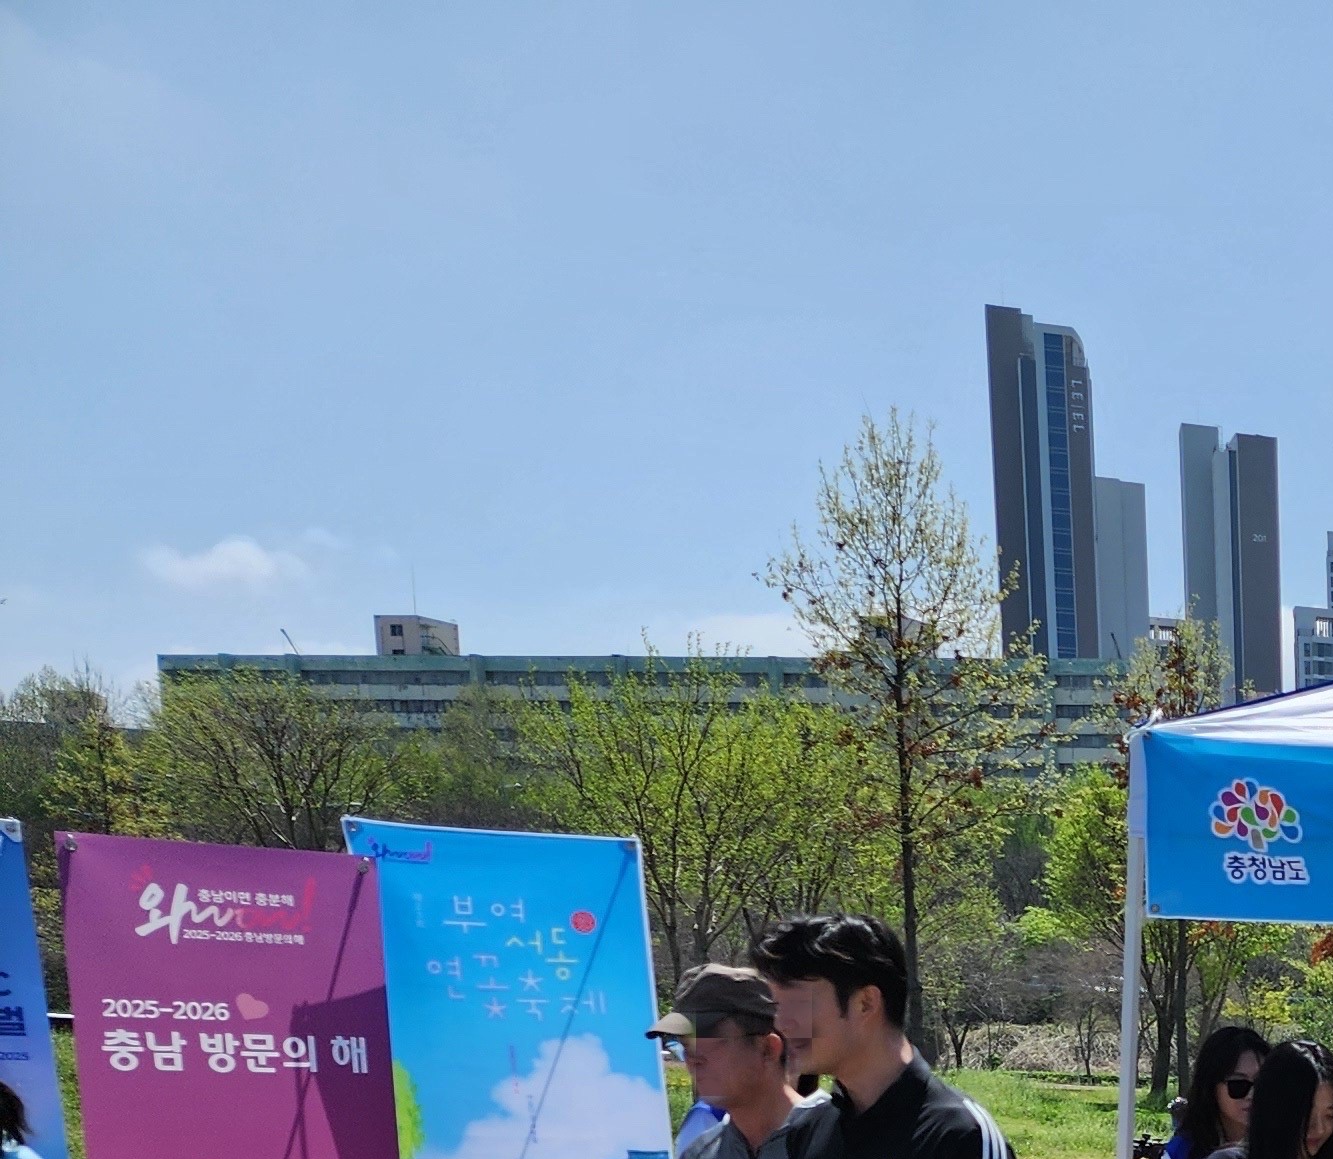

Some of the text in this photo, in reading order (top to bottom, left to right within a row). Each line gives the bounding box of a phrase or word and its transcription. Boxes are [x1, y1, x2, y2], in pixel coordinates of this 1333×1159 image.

[1226, 854, 1308, 885] 충청남도
[198, 888, 295, 907] 충남이면 충분해
[443, 895, 527, 934] 부여
[183, 928, 243, 942] 2025-2026
[505, 927, 580, 981] 서동
[101, 998, 231, 1021] 2025-2026
[101, 1029, 369, 1074] 충남 방문의 해
